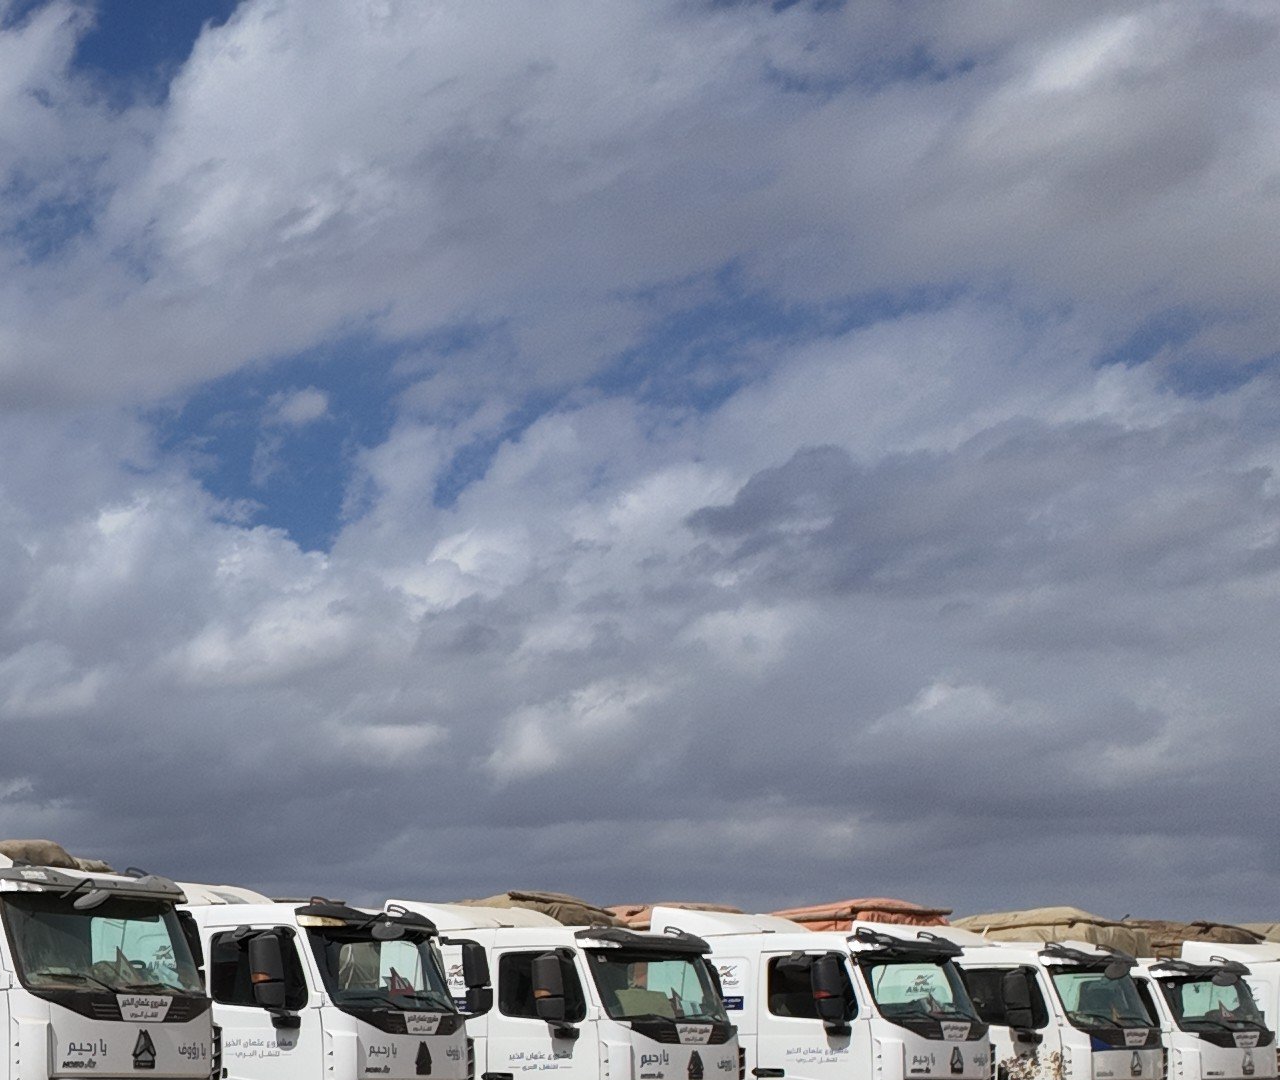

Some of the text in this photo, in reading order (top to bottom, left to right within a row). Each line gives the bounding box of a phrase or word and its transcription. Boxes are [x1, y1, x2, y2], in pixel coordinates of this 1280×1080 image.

[68, 1038, 107, 1056] يا رحيم
[369, 1046, 390, 1058] رحيم
